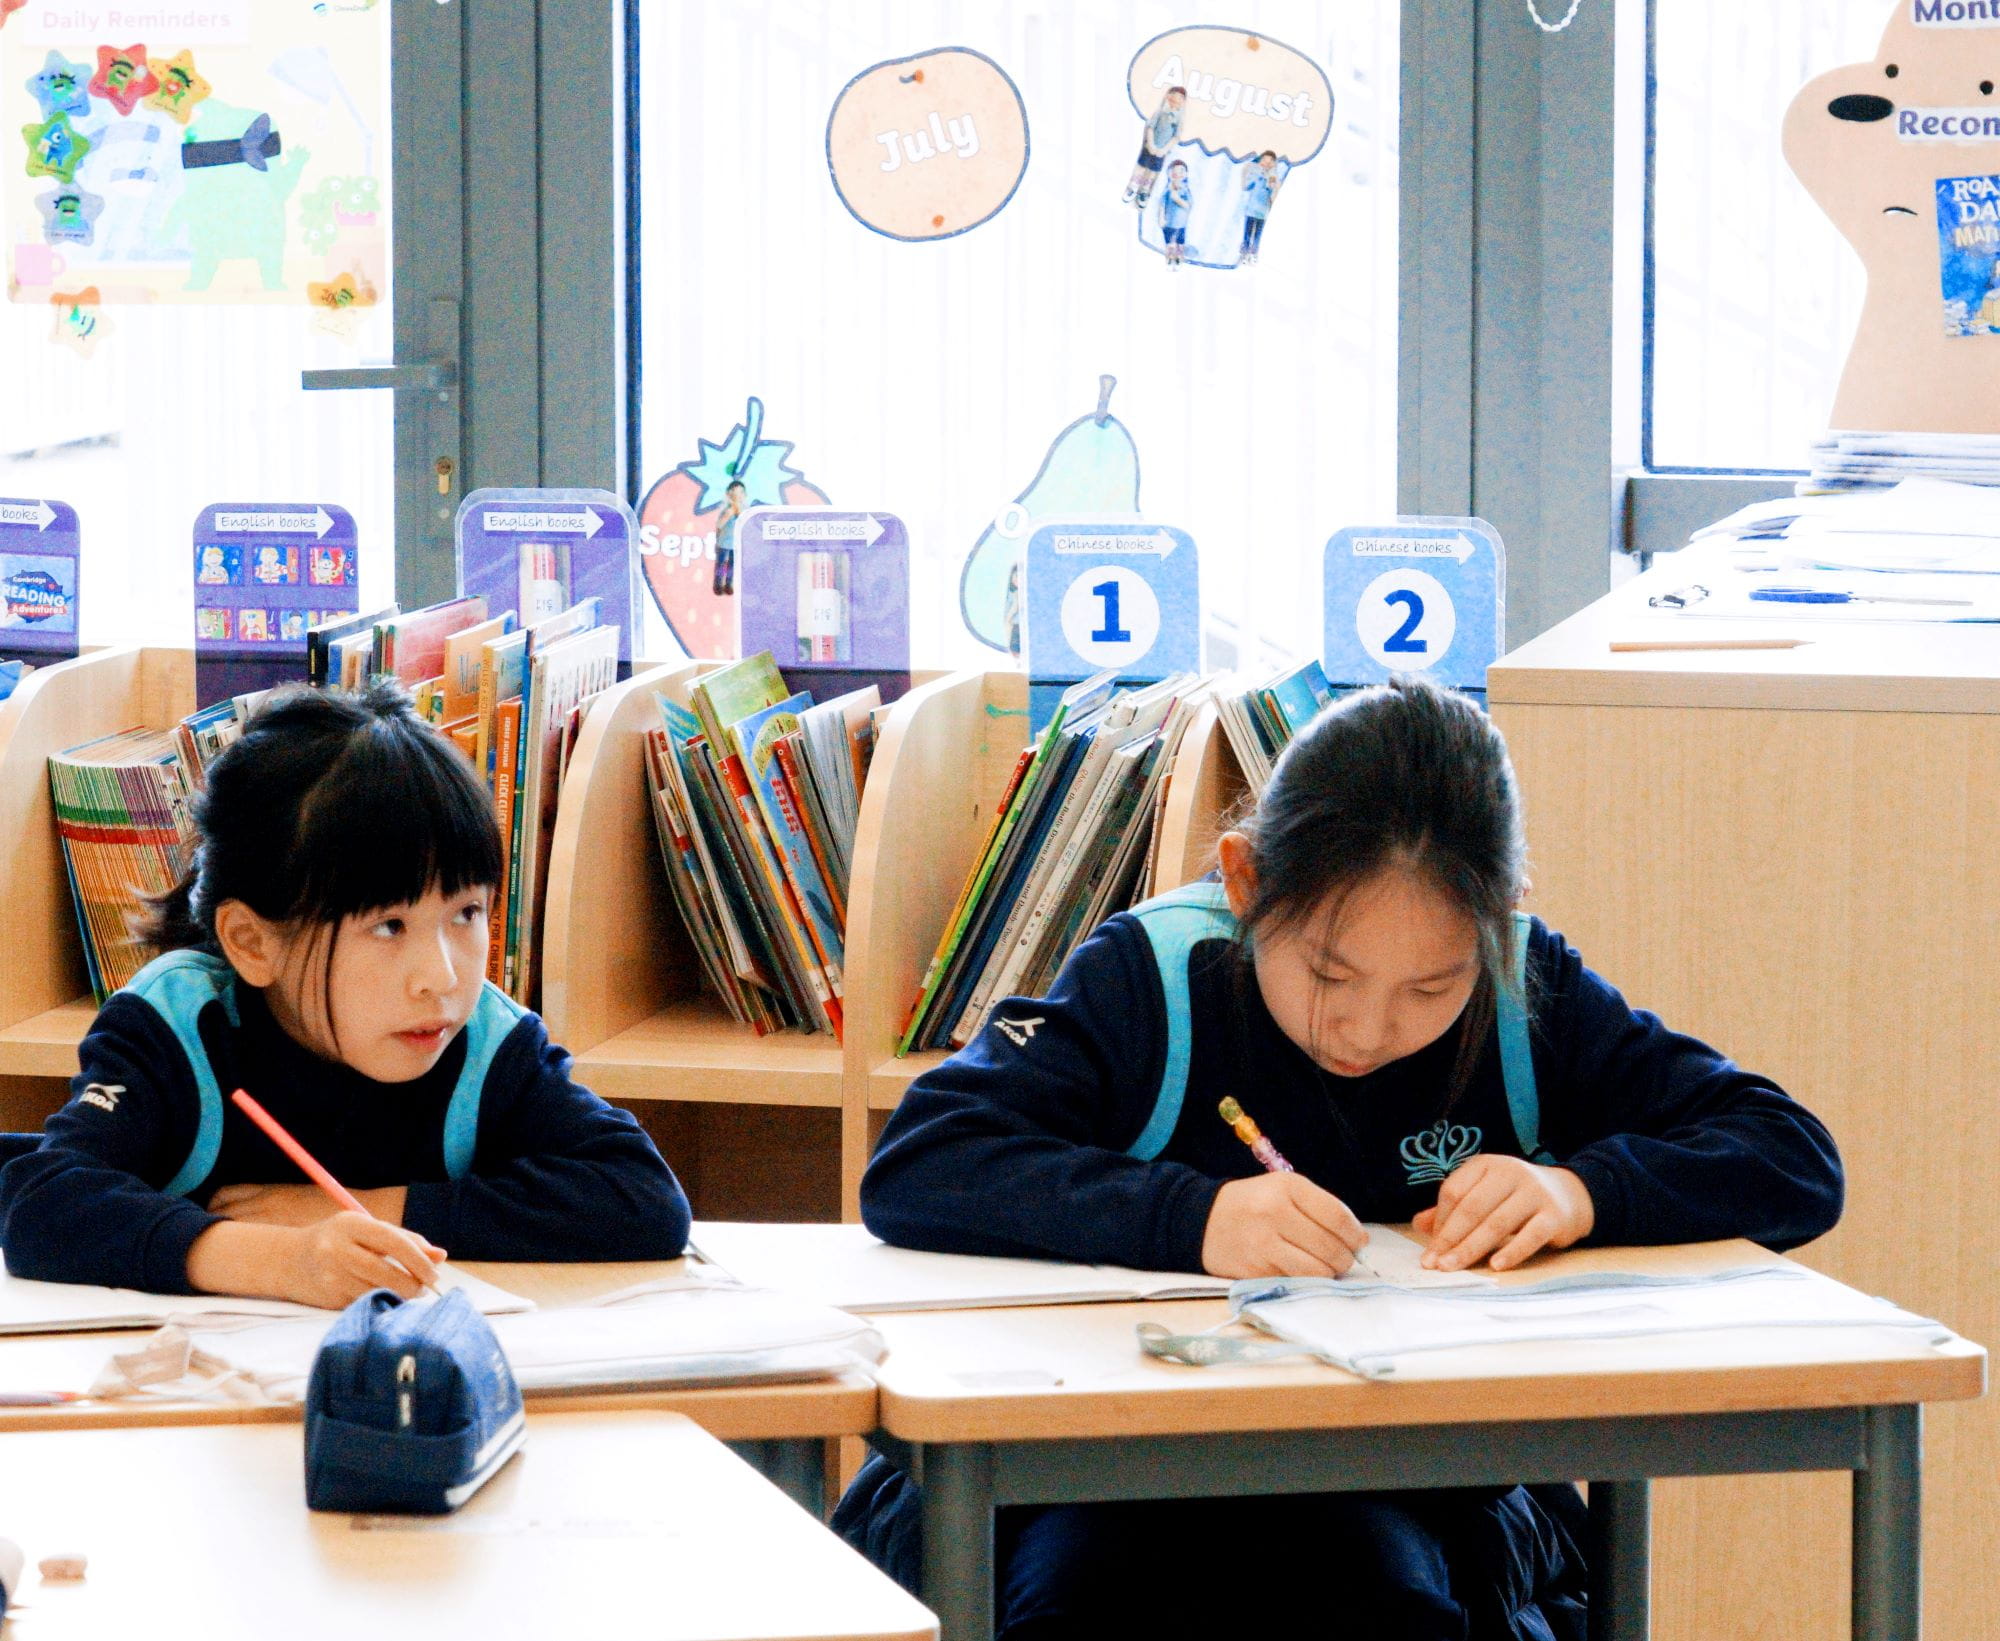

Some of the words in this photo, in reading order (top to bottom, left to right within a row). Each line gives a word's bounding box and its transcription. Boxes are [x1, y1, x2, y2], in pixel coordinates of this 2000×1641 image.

[43, 10, 99, 33] Daily
[107, 9, 232, 29] Reminders
[1914, 0, 2000, 22] Mont
[1151, 55, 1314, 127] August
[875, 111, 980, 172] July
[1952, 177, 2000, 202] ROA
[2, 507, 39, 521] books
[221, 514, 275, 531] English
[279, 514, 317, 528] books
[490, 514, 543, 531] English
[547, 514, 585, 528] books
[768, 522, 823, 540] English
[827, 522, 865, 536] books
[1057, 537, 1112, 550] Chinese
[1116, 537, 1154, 550] books
[1355, 540, 1410, 553] Chinese
[1414, 541, 1453, 554] books
[2, 583, 66, 607] READING
[12, 604, 64, 614] Adventures
[1092, 581, 1131, 642] 1
[1383, 589, 1427, 653] 2
[497, 773, 509, 797] CLICK
[490, 922, 500, 940] FOR
